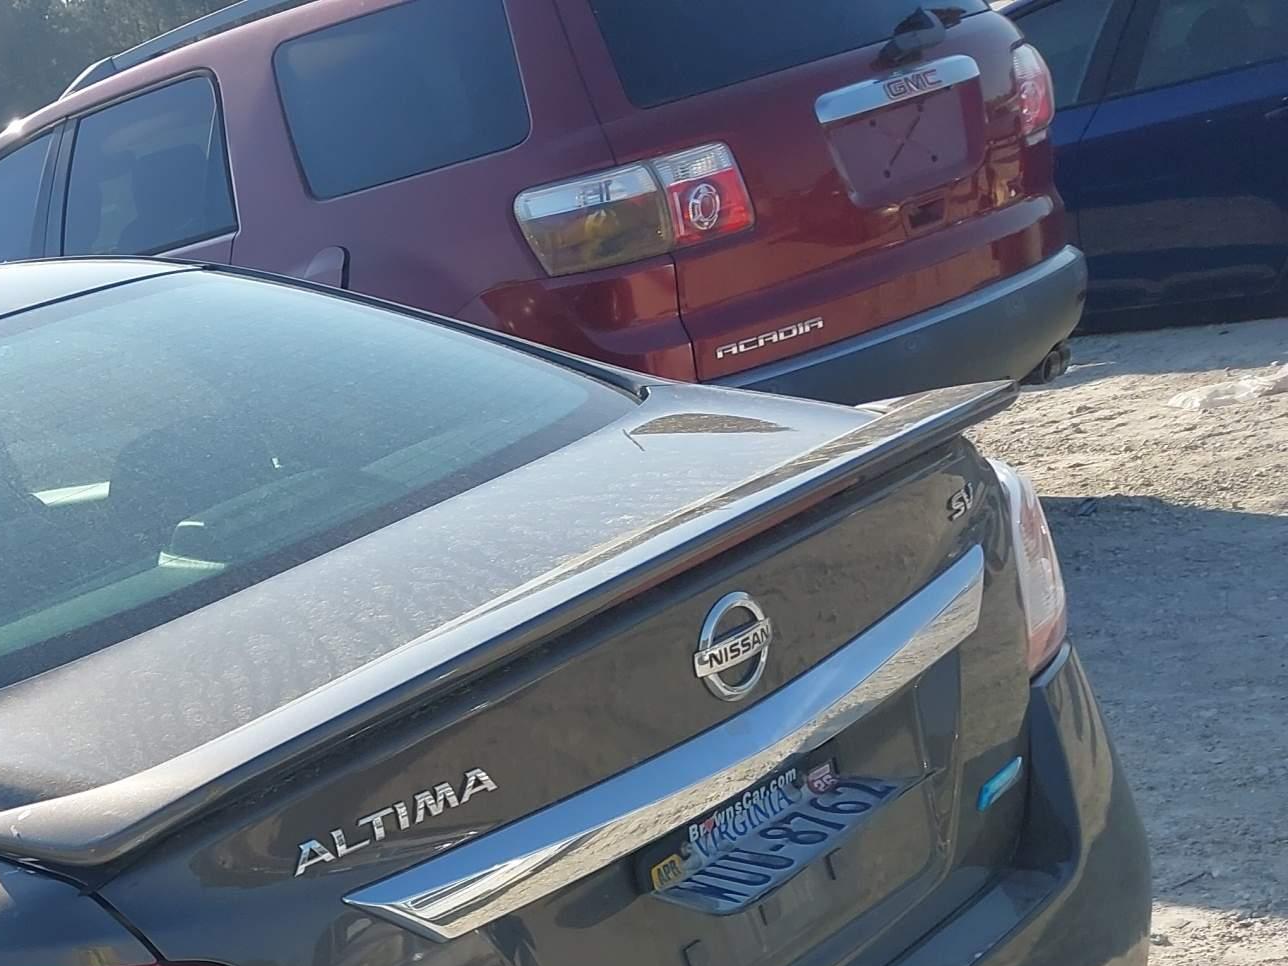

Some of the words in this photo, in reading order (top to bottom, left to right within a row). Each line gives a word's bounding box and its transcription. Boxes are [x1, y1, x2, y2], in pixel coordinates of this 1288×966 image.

[883, 69, 943, 99] GMC
[716, 317, 824, 359] ACADIA
[708, 624, 770, 668] NISSAN
[294, 767, 499, 877] ALTIMA
[694, 786, 795, 857] VIRGINIA
[657, 859, 682, 886] APR
